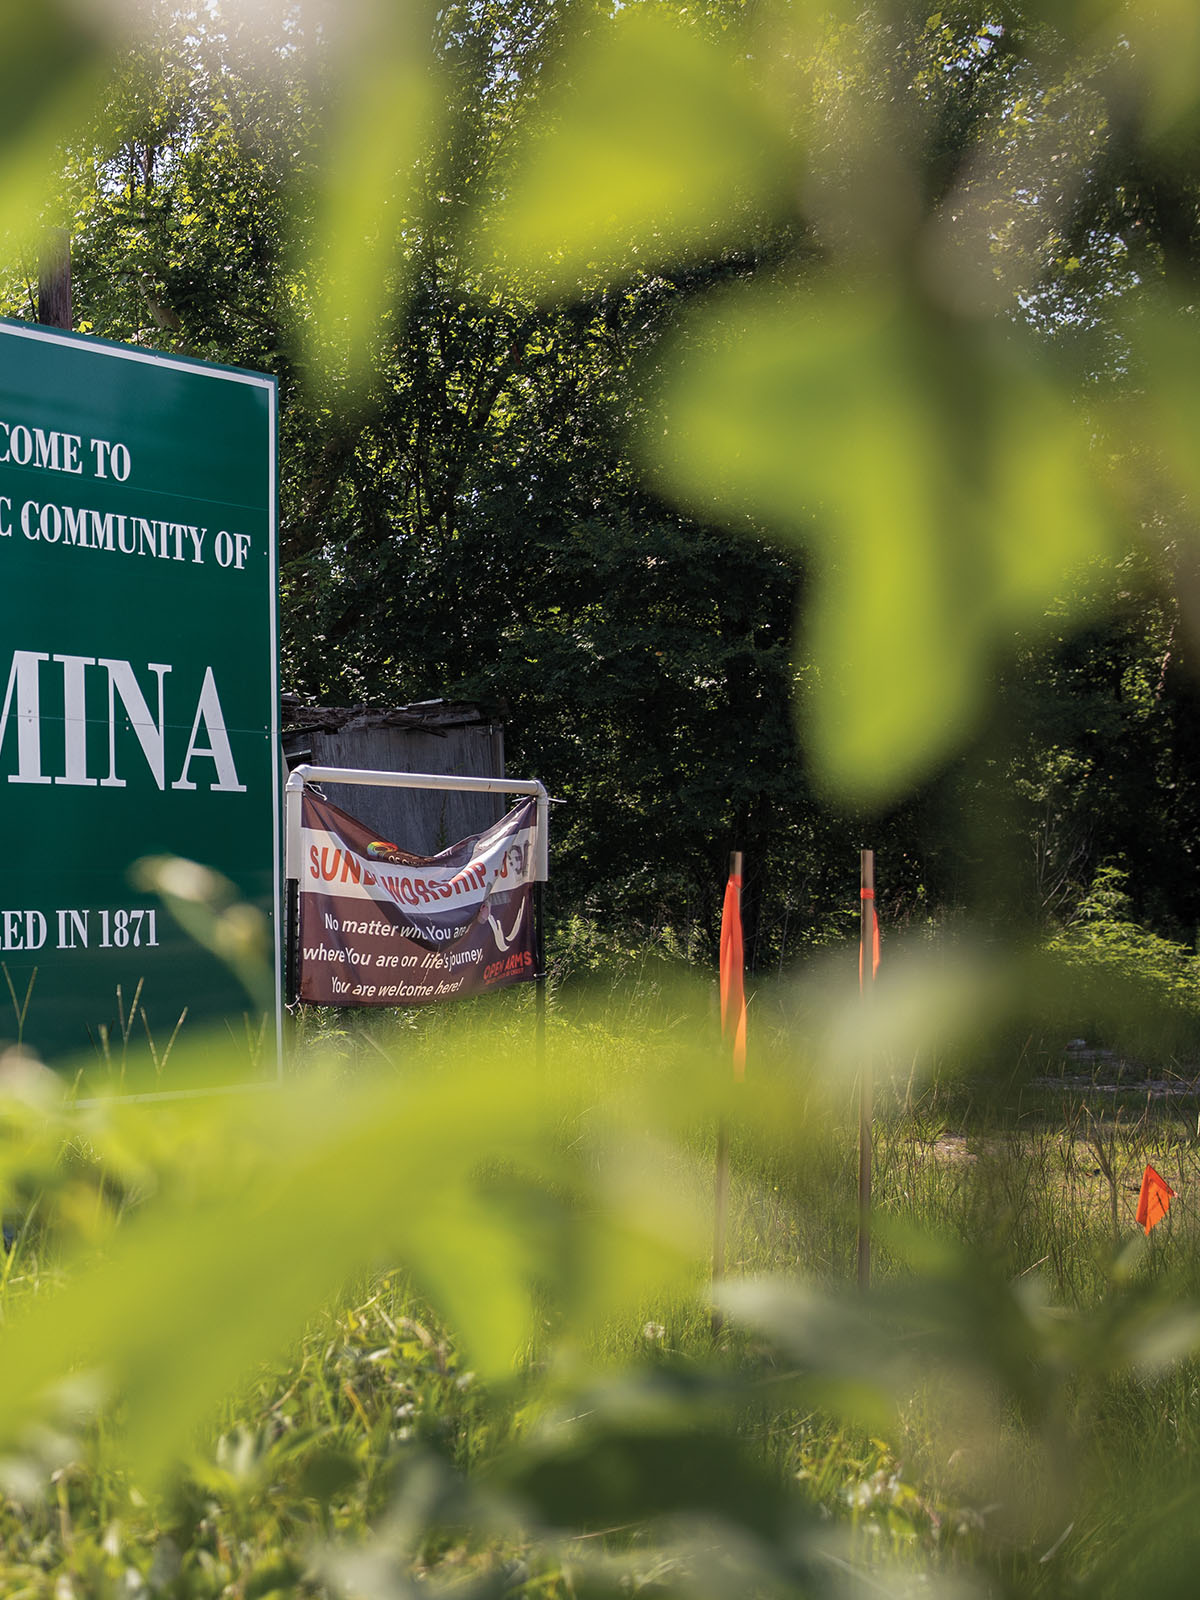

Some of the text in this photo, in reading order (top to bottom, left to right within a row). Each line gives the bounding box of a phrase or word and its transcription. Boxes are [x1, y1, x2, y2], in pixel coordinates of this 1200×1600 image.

[91, 439, 131, 482] TO
[21, 500, 207, 564] COMMUNITY
[215, 531, 251, 570] OF
[56, 910, 89, 949] IN
[98, 909, 159, 948] 1871
[325, 913, 339, 931] No
[342, 920, 399, 937] matter
[426, 925, 451, 940] You
[303, 943, 345, 962] where
[345, 947, 371, 965] You
[376, 954, 399, 967] are
[401, 955, 418, 967] on
[420, 953, 448, 969] life's
[504, 951, 533, 971] ARMS
[331, 976, 464, 997] You are welcome here!
